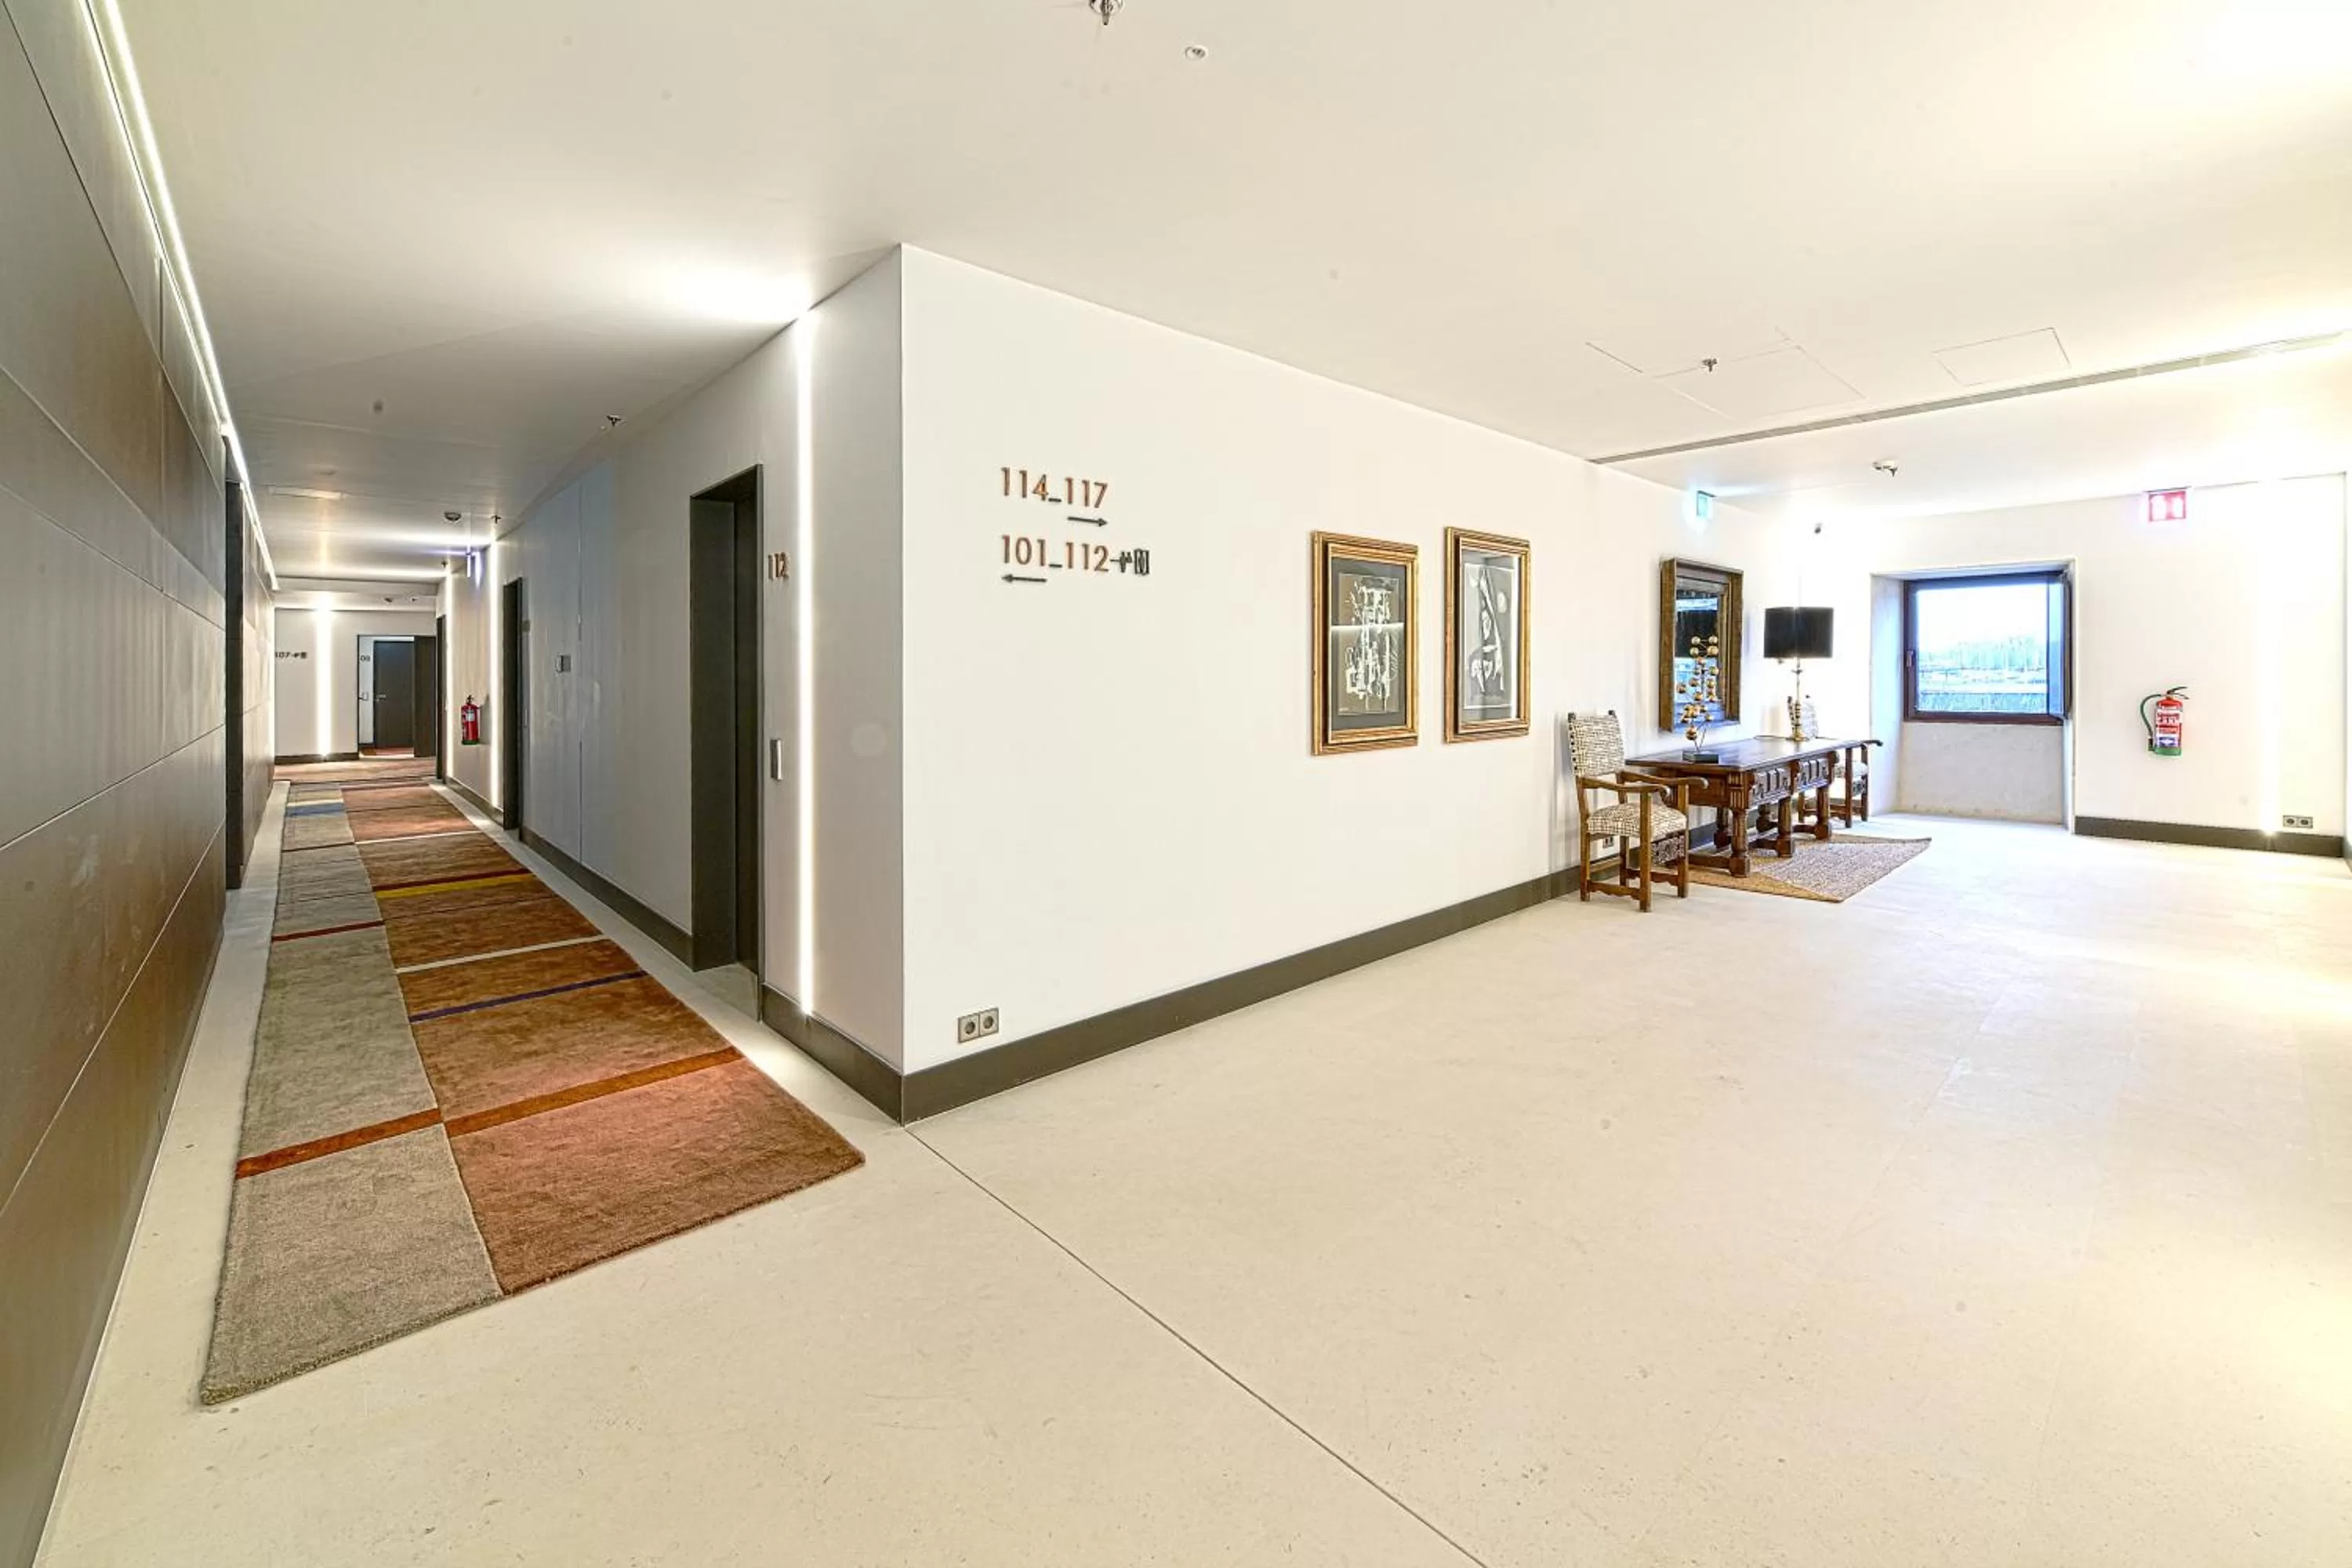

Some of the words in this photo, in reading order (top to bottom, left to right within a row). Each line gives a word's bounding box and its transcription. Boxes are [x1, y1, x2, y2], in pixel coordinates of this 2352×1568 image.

[1000, 466, 1108, 508] 114_117
[768, 552, 789, 581] 112
[1001, 535, 1109, 572] 101_112
